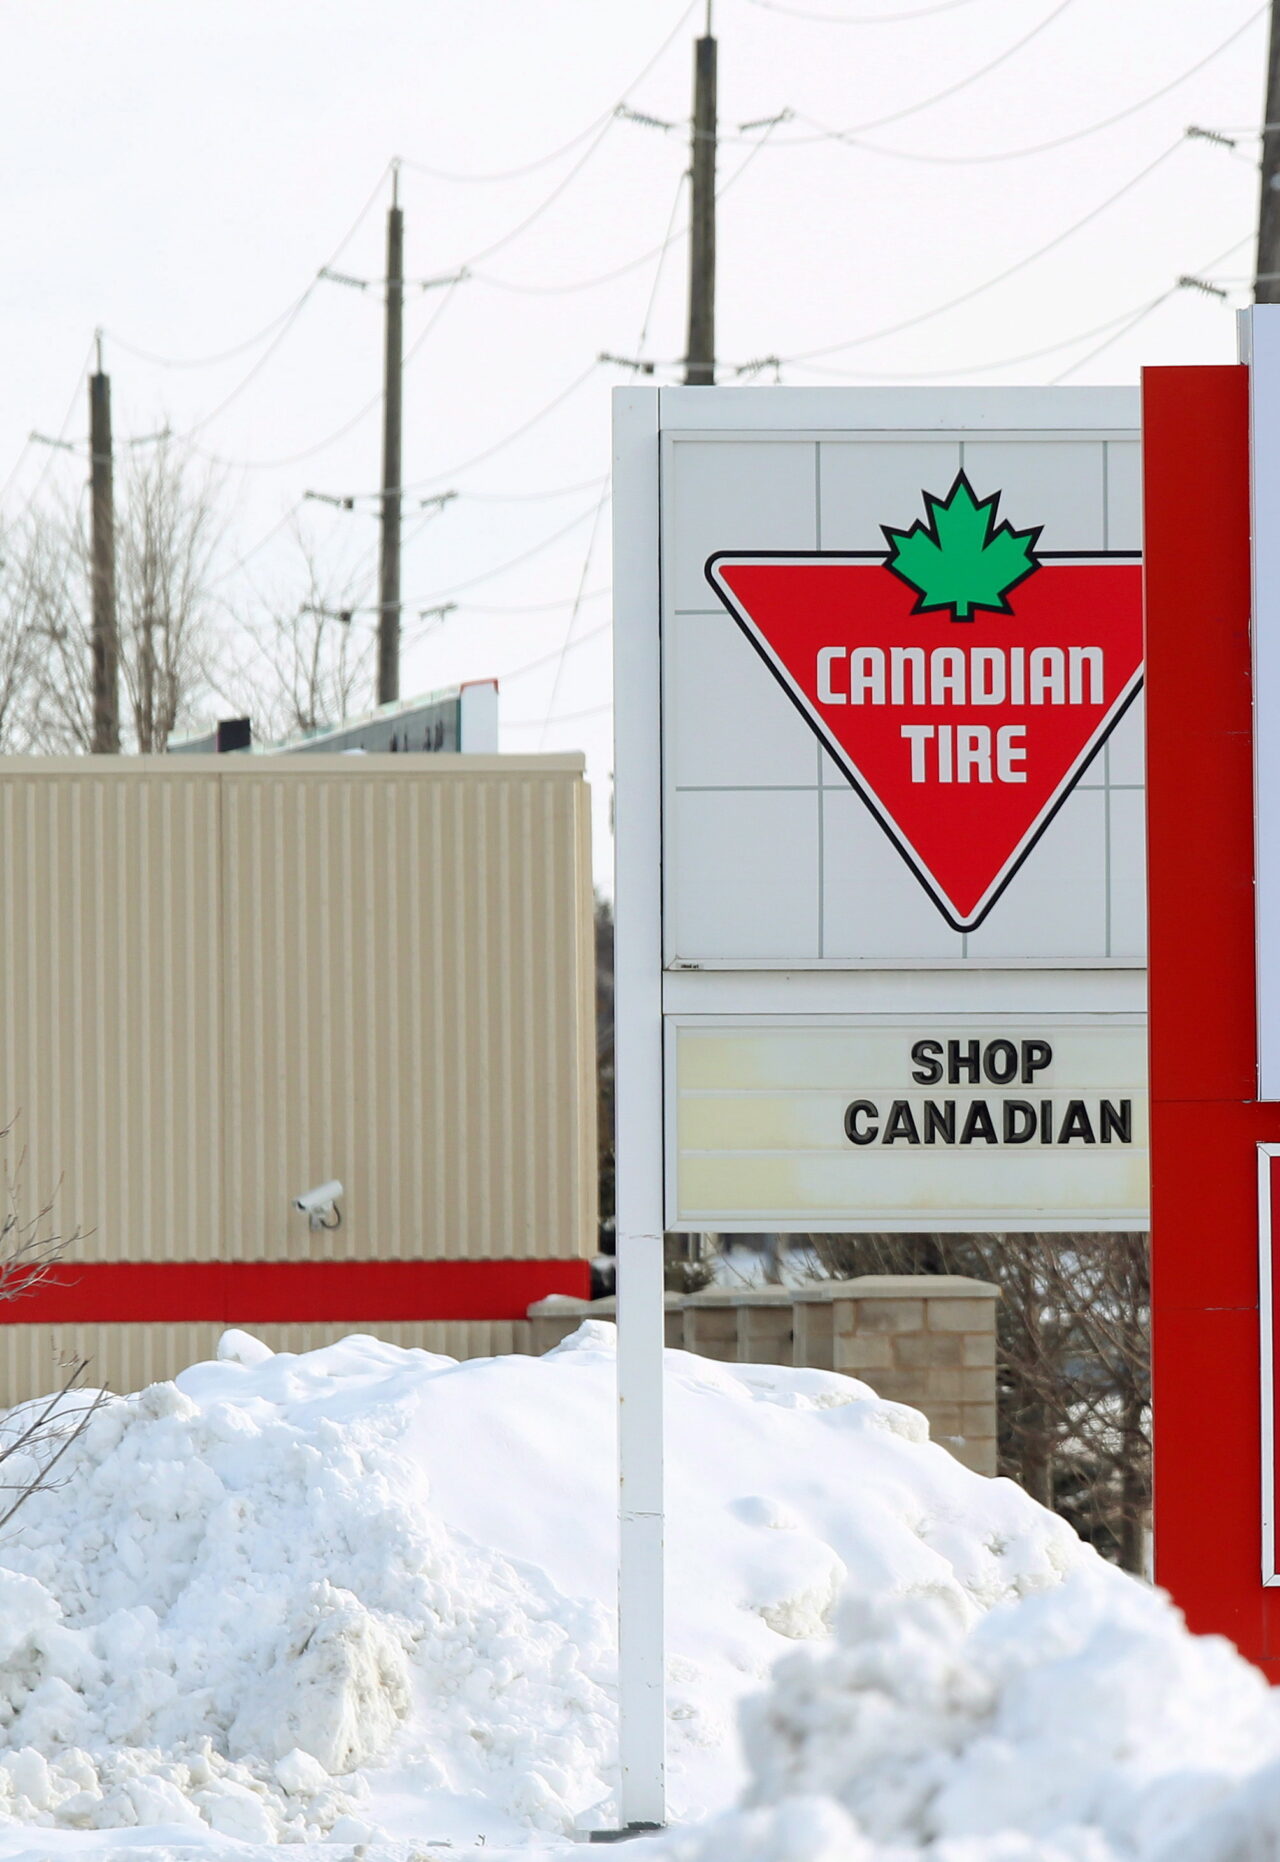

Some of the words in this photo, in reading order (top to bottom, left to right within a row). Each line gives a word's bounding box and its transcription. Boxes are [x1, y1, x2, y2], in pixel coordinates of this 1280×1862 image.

[816, 647, 1104, 705] CANADIAN
[901, 725, 1027, 783] TIRE
[911, 1039, 1053, 1085] SHOP
[844, 1099, 1132, 1145] CANADIAN
